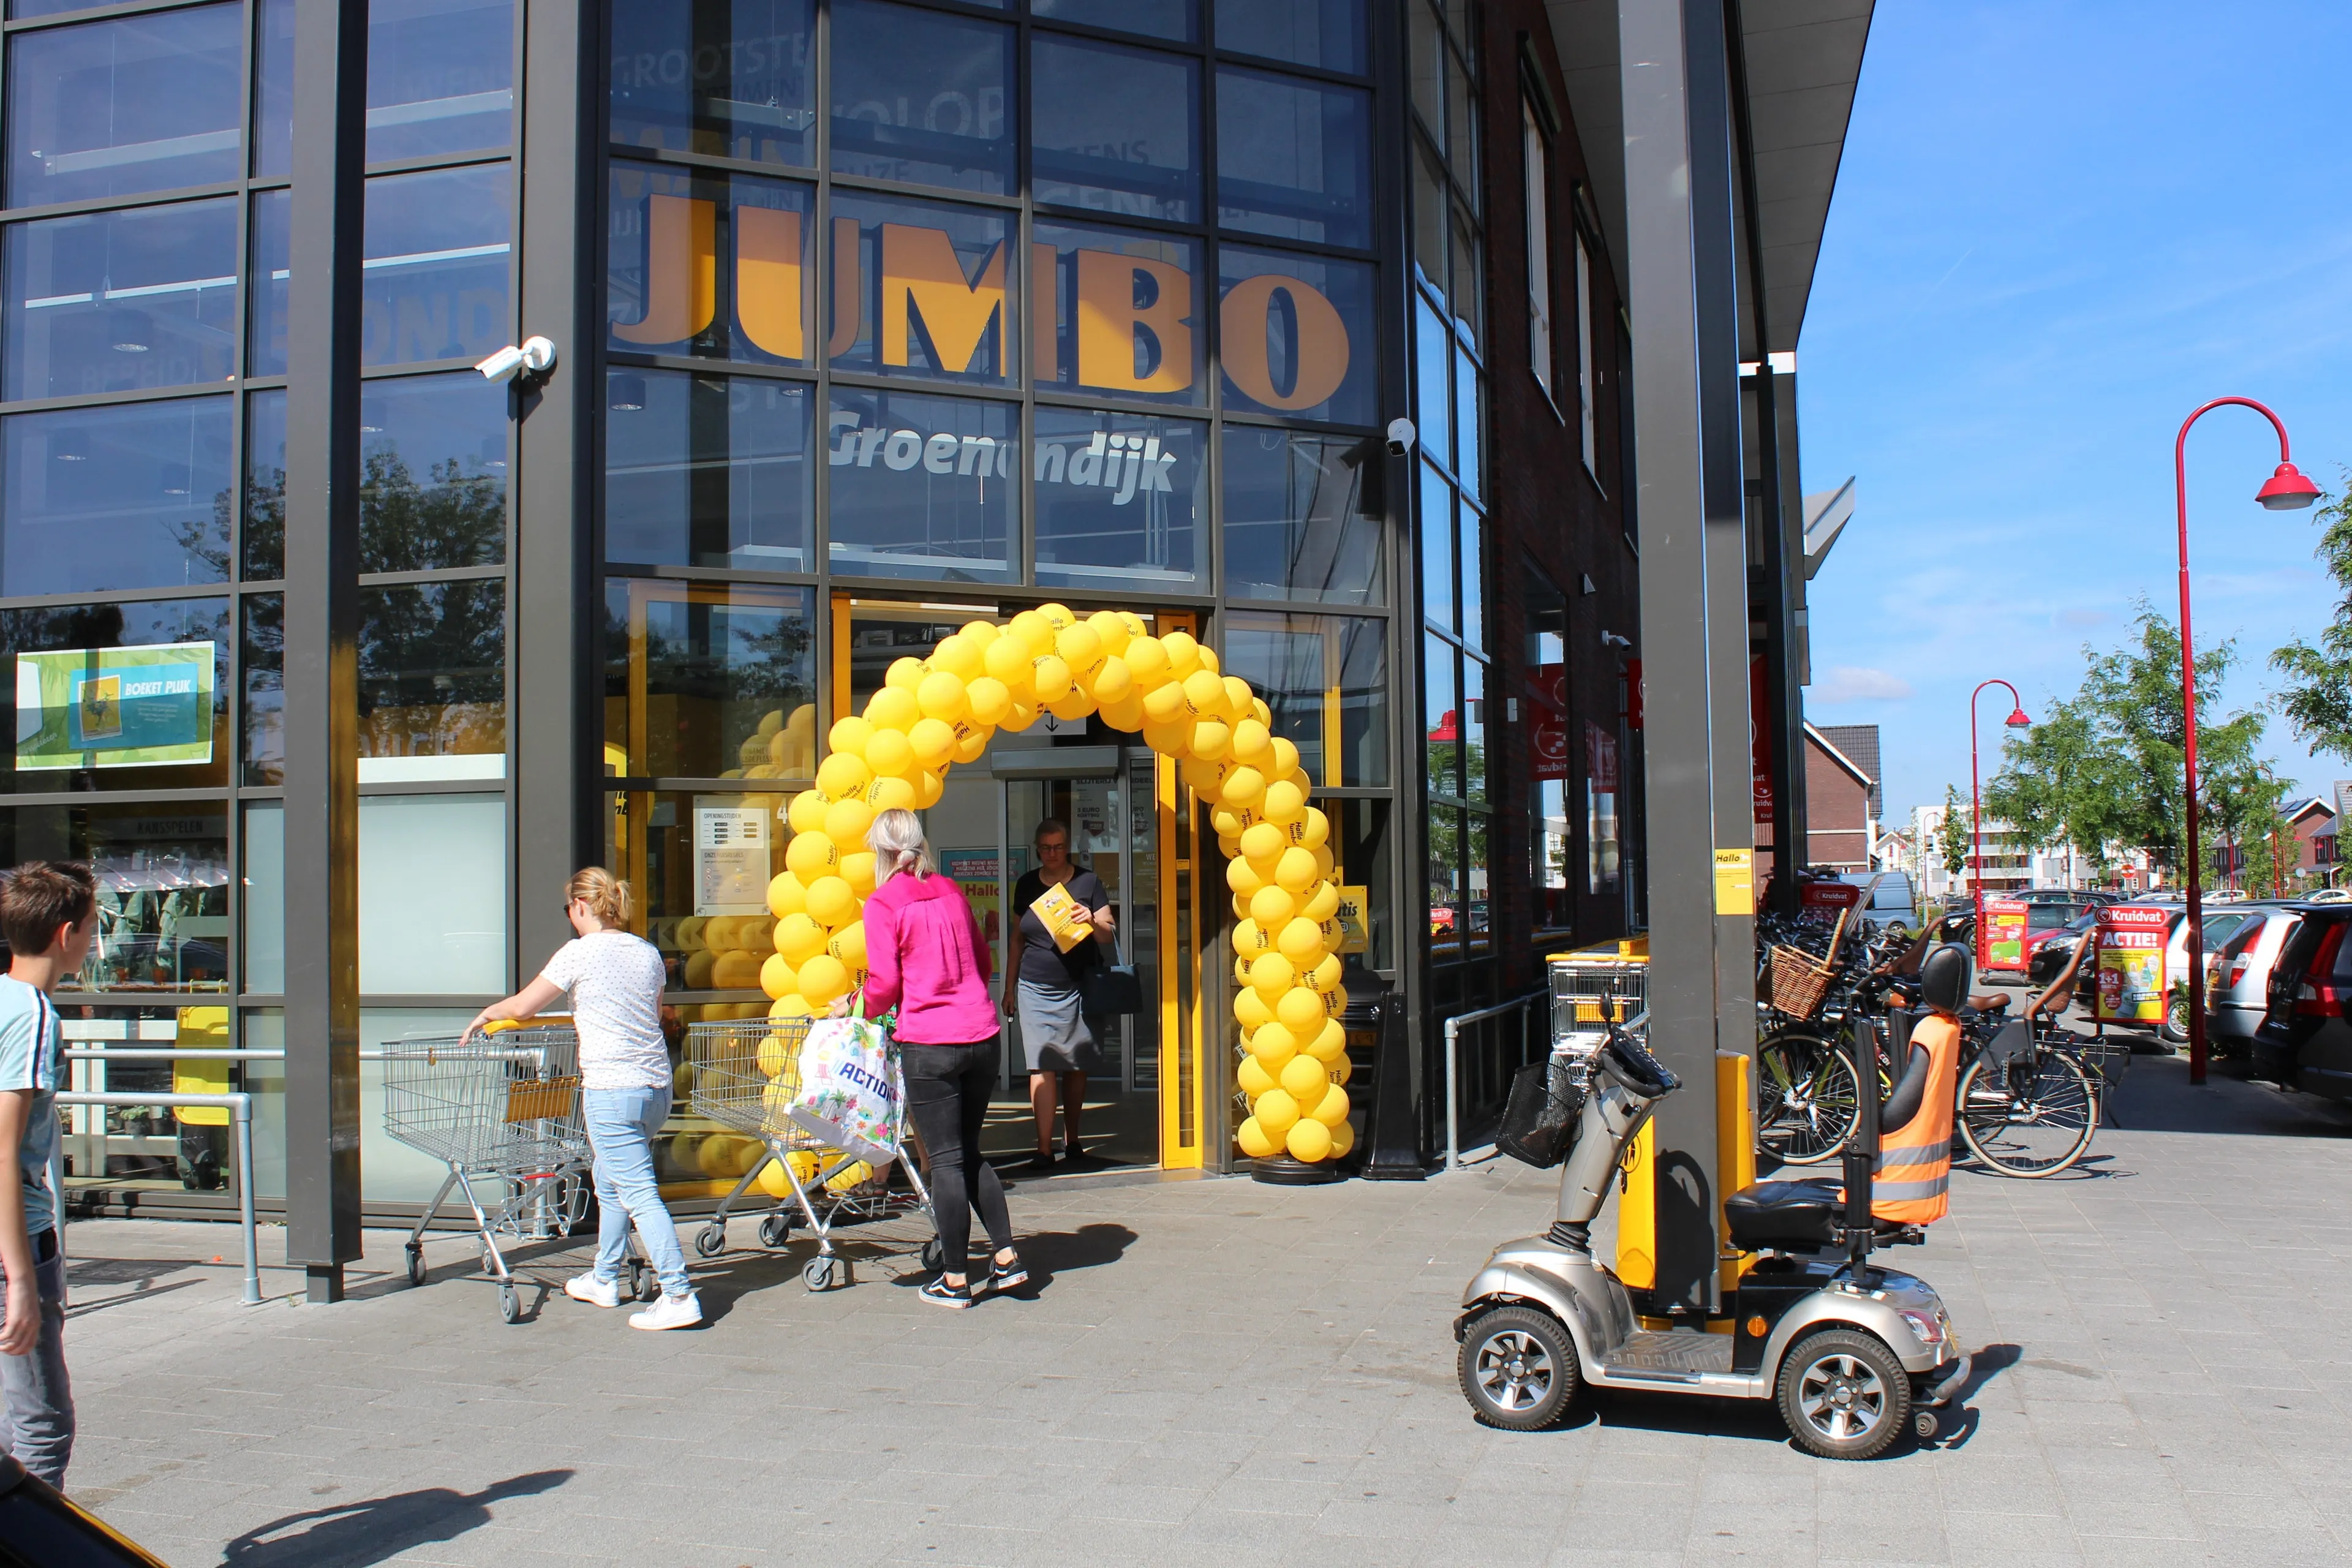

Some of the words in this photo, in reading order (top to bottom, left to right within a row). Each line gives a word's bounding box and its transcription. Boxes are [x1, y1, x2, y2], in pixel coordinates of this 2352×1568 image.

[612, 194, 1350, 411] JUMBO
[829, 411, 1177, 505] Groenndijk
[125, 680, 162, 696] BOEKET
[165, 679, 192, 693] PLUK
[1186, 699, 1199, 714] Hallo
[956, 726, 970, 741] Hall
[840, 785, 857, 799] Hallo
[850, 780, 865, 799] mbo!
[873, 782, 883, 800] Hallo
[137, 820, 203, 834] KANSSPELEN
[965, 884, 1000, 897] Hallo
[2111, 910, 2162, 922] Kruidvat
[2102, 932, 2157, 947] ACTIE!
[834, 941, 843, 960] Hallo
[1309, 970, 1319, 990] Hallo
[2098, 973, 2119, 984] 1+1
[1322, 993, 1332, 1016] Jumbo!
[1329, 990, 1338, 1008] Hallo
[839, 1062, 892, 1105] ACTION
